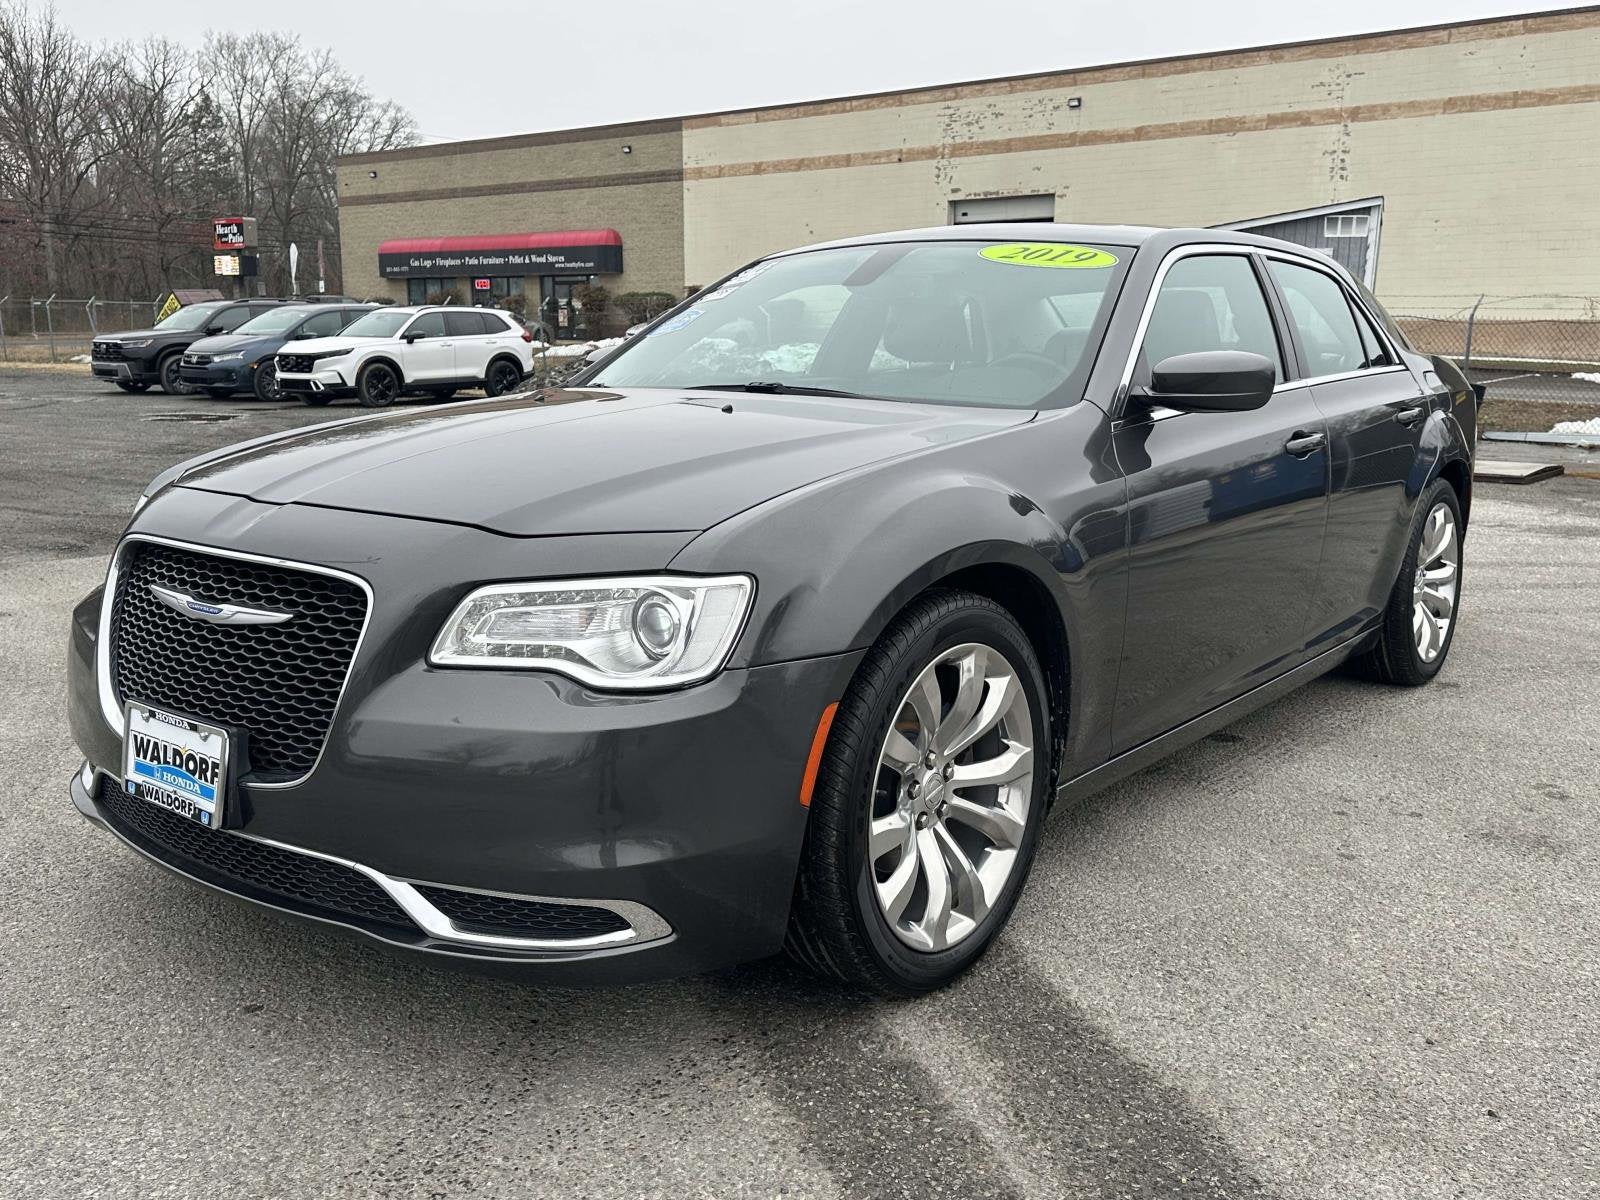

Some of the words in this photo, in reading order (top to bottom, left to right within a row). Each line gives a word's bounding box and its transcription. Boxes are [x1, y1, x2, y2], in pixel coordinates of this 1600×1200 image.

[216, 224, 238, 234] Hearth
[228, 233, 243, 244] Patio
[410, 258, 419, 267] Gas
[420, 258, 432, 268] Logs
[436, 257, 461, 267] Fireplaces
[465, 256, 478, 265] Patio
[480, 256, 504, 265] Furniture
[509, 255, 524, 264] Pellet
[524, 255, 530, 264] &
[531, 254, 546, 263] Wood
[547, 254, 565, 263] Stoves
[996, 247, 1098, 263] 2019
[188, 602, 218, 614] CHRYSLER
[155, 711, 190, 730] HONDA
[133, 733, 220, 785] WALDORF
[163, 771, 201, 794] HONDA
[143, 783, 194, 816] WALDORF
